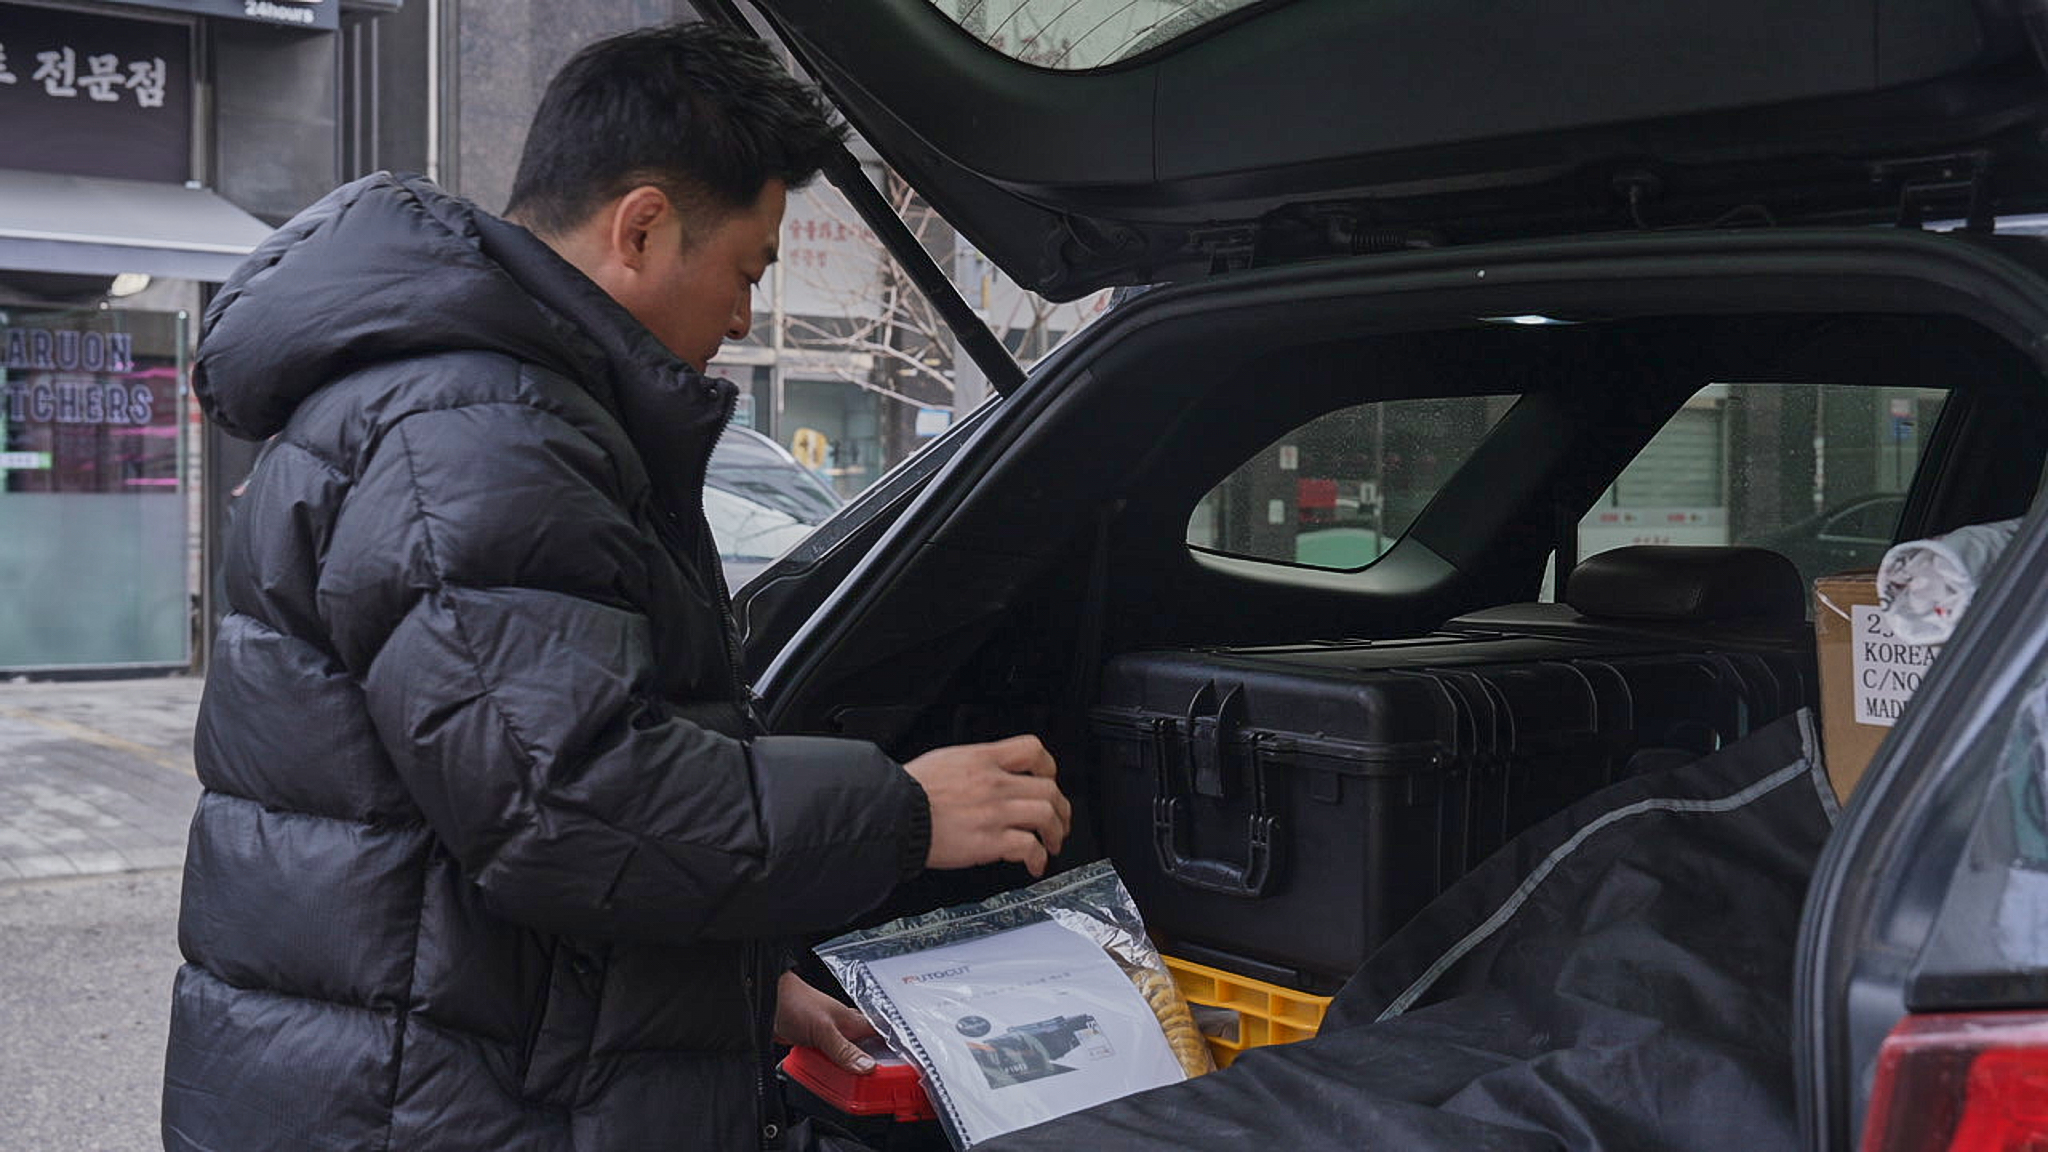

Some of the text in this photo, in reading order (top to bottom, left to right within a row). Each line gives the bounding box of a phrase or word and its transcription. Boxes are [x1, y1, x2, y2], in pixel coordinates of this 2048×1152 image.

[244, 0, 314, 23] 24hours
[33, 46, 166, 107] 전문점
[1867, 613, 1894, 637] 2
[1866, 697, 1908, 718] MAD
